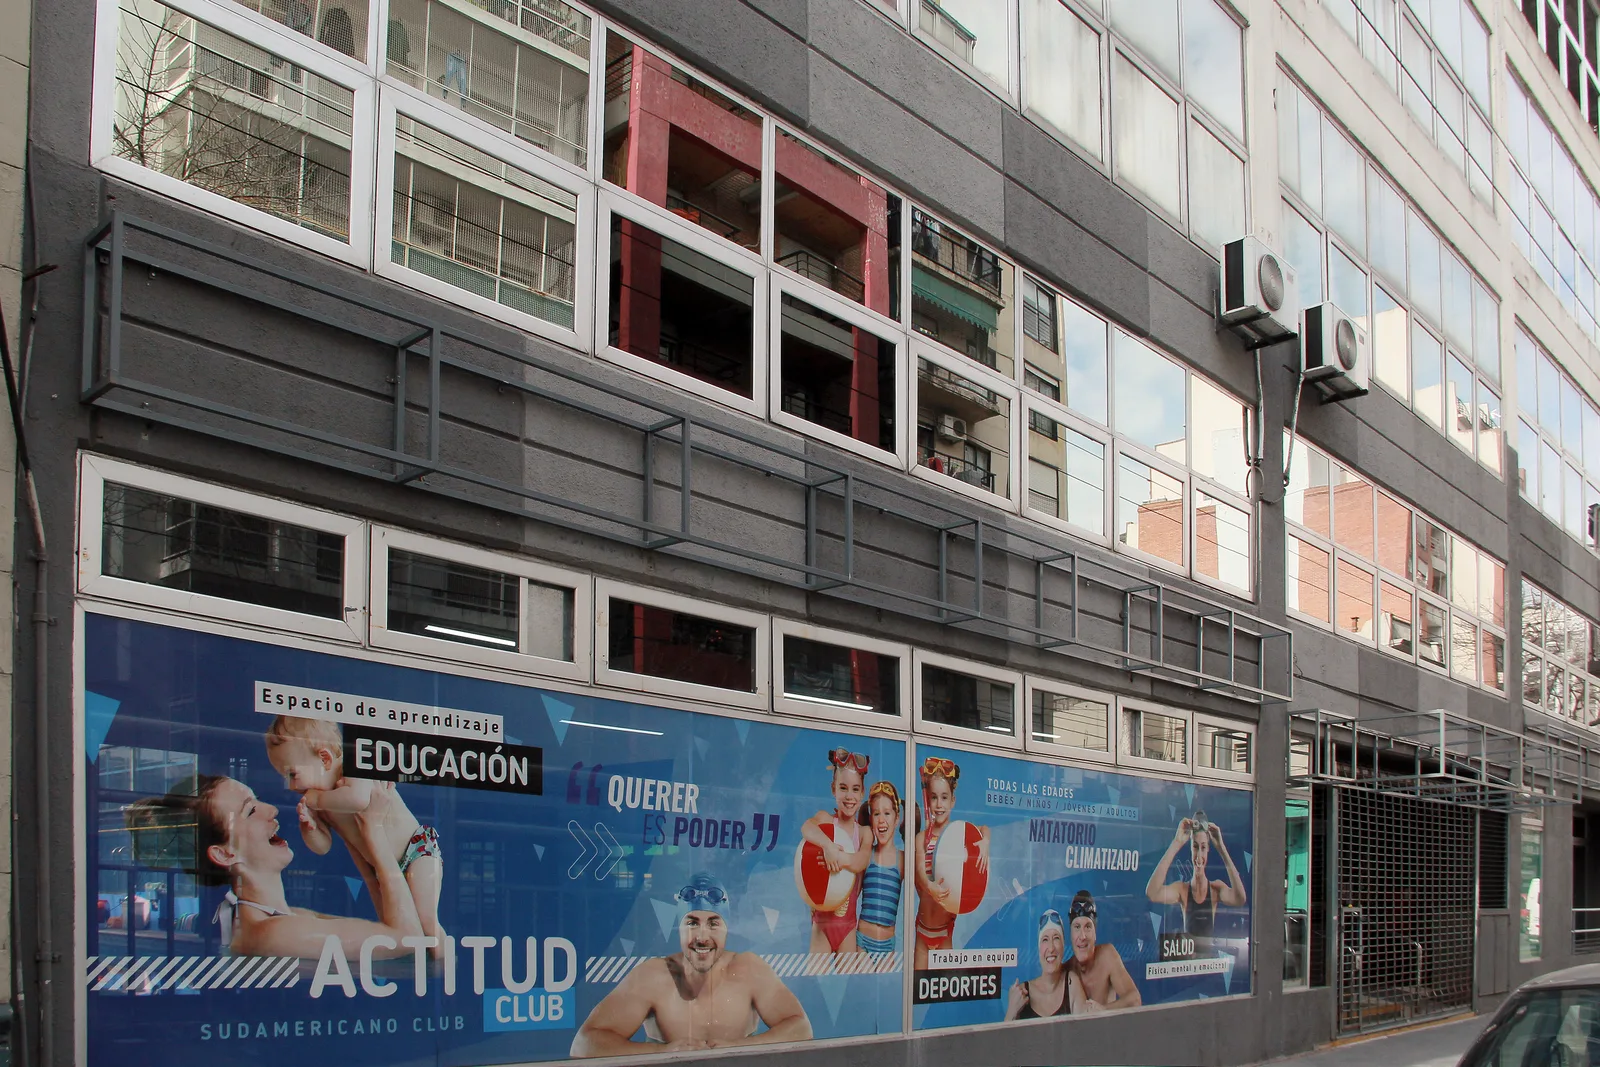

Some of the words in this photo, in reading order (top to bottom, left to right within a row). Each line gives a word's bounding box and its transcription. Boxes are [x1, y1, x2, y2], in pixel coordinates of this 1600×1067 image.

[262, 688, 343, 713] Espacio
[356, 702, 377, 718] de
[388, 708, 500, 735] aprendizaje
[355, 737, 528, 786] EDUCACIÓN
[607, 774, 699, 813] QUERER
[987, 778, 1017, 792] TODAS
[1021, 782, 1038, 795] LAS
[1042, 785, 1074, 799] EDADES
[987, 793, 1014, 805] BEBÉS
[1026, 798, 1051, 809] NIÑOS
[1062, 801, 1096, 814] JÓVENES
[1106, 807, 1137, 819] ADULTOS
[643, 813, 666, 845] ES
[673, 816, 746, 849] PODER
[1029, 818, 1096, 846] NATATORIO
[1065, 846, 1139, 872] CLIMATIZADO
[932, 953, 968, 964] Trabajo
[972, 954, 982, 962] en
[986, 952, 1015, 963] equipo
[1163, 939, 1195, 957] SALUD
[309, 935, 577, 998] ACTITUD
[1171, 964, 1191, 973] mental
[919, 974, 997, 1000] DEPORTES
[495, 994, 564, 1023] CLUB
[200, 1018, 398, 1040] SUDAMERICANO
[412, 1015, 464, 1032] CLUB
